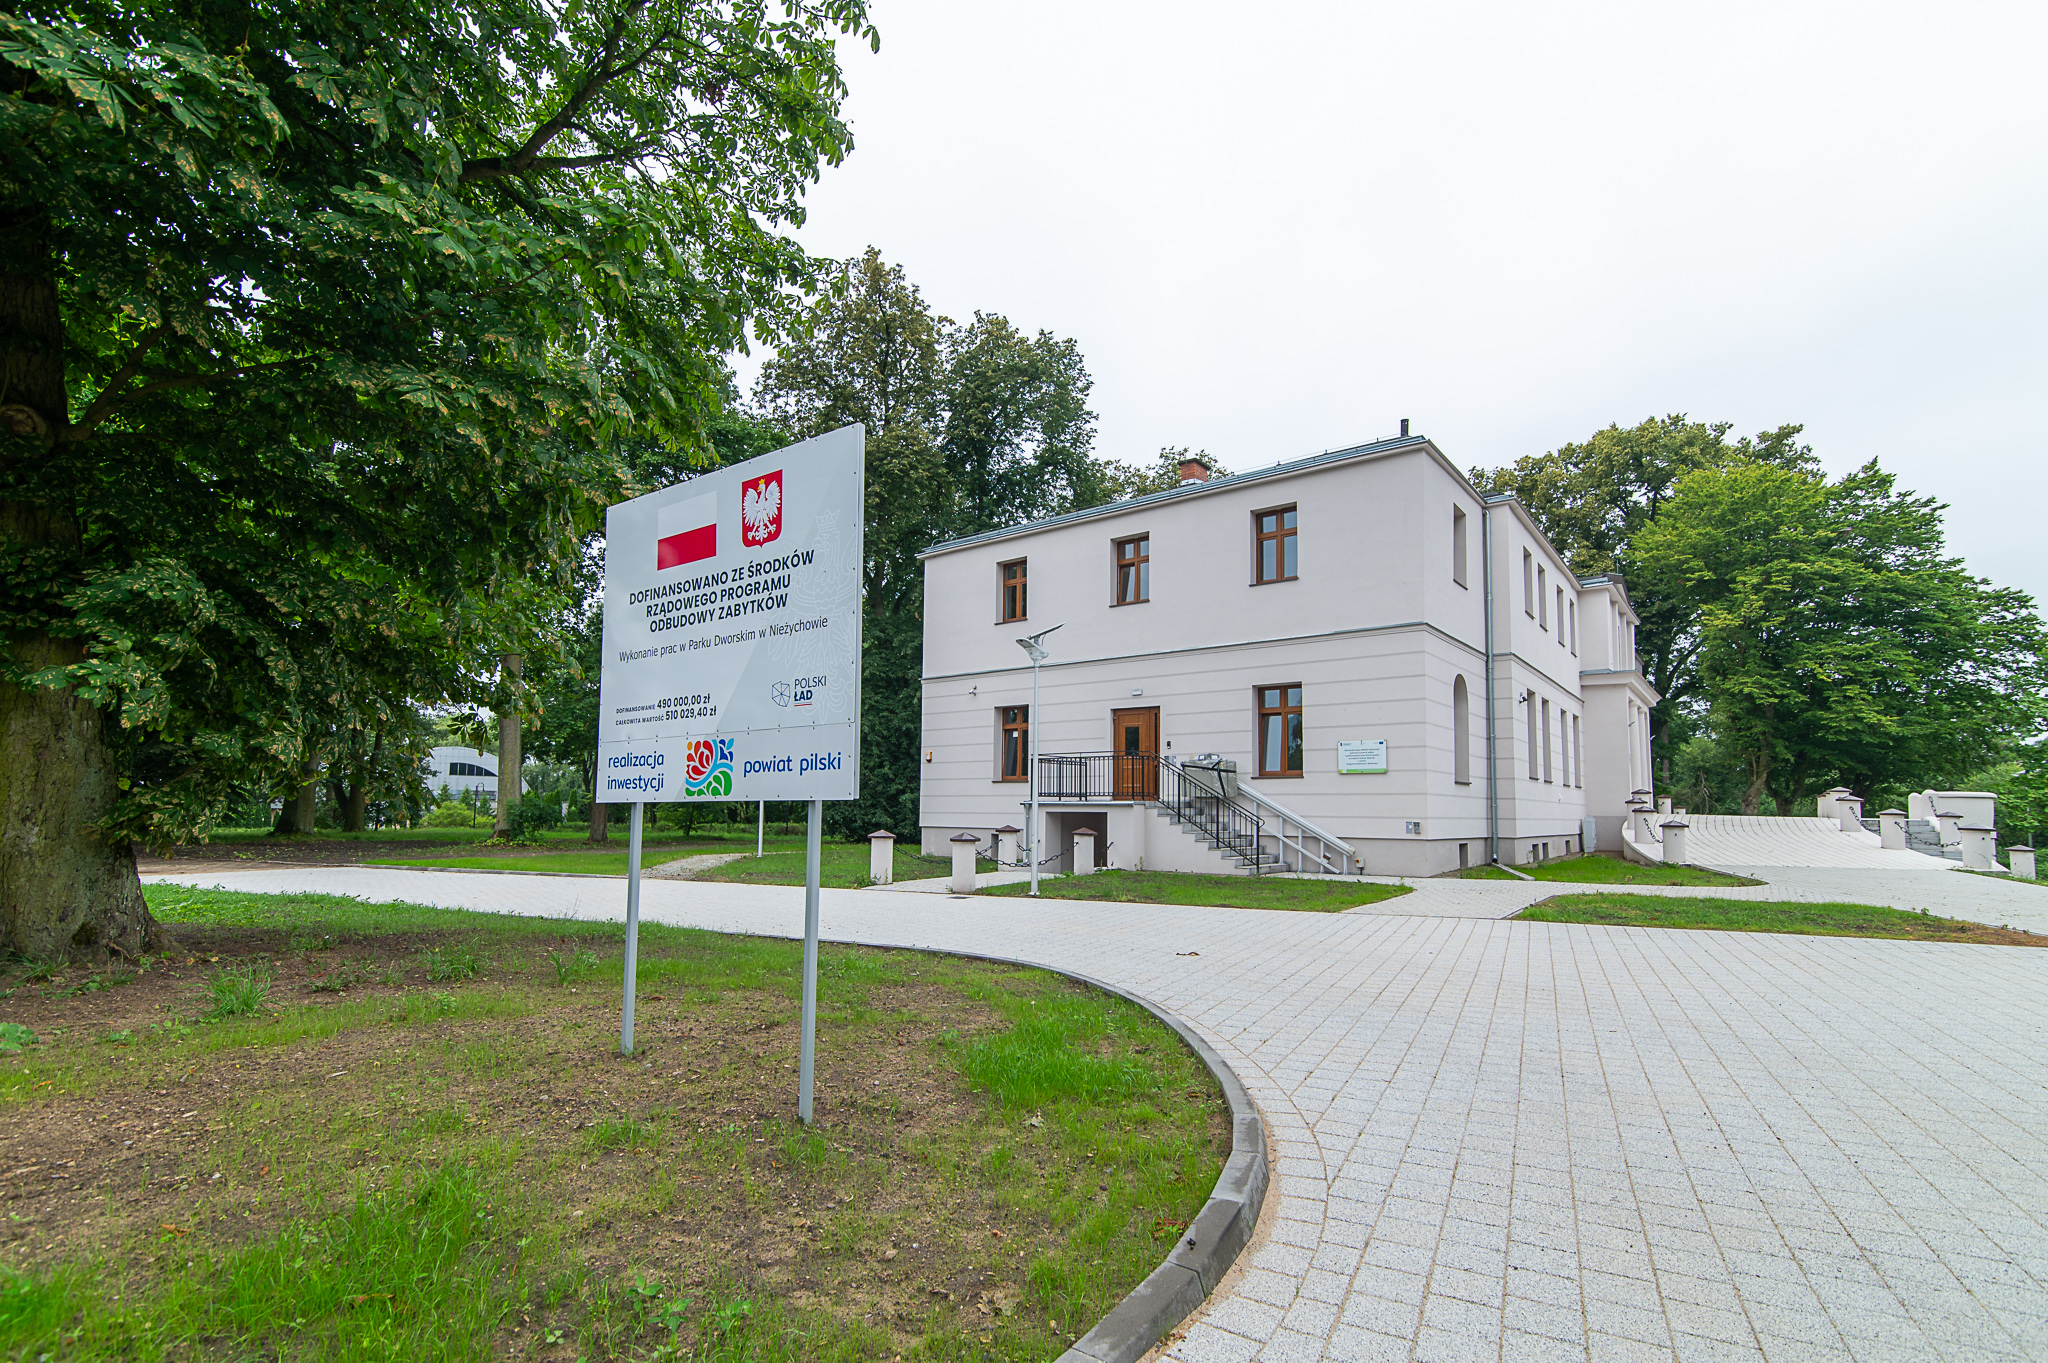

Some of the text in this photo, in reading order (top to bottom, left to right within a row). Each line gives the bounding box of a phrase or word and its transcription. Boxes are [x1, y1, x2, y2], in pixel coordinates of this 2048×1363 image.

[629, 549, 815, 605] DOFINANSOWANO ZE ŚRODKÓW
[646, 574, 791, 618] RZĄDOWEGO PROGRAMU
[650, 593, 788, 632] ODBUDOWY ZABYTKÓW
[619, 616, 828, 662] Wykonanie prac w Parku Dworskim w Nieżychowie
[794, 675, 827, 689] POLSKI
[616, 693, 710, 714] DOFINANSOWANIE 490 000,00 zł
[794, 690, 812, 701] ŁAD
[616, 707, 716, 726] CAŁKOWITA WARTOŚĆ 510 029,40 zł
[608, 751, 664, 769] realizacja
[744, 752, 841, 777] powiat pilski
[607, 773, 664, 792] inwestycji
